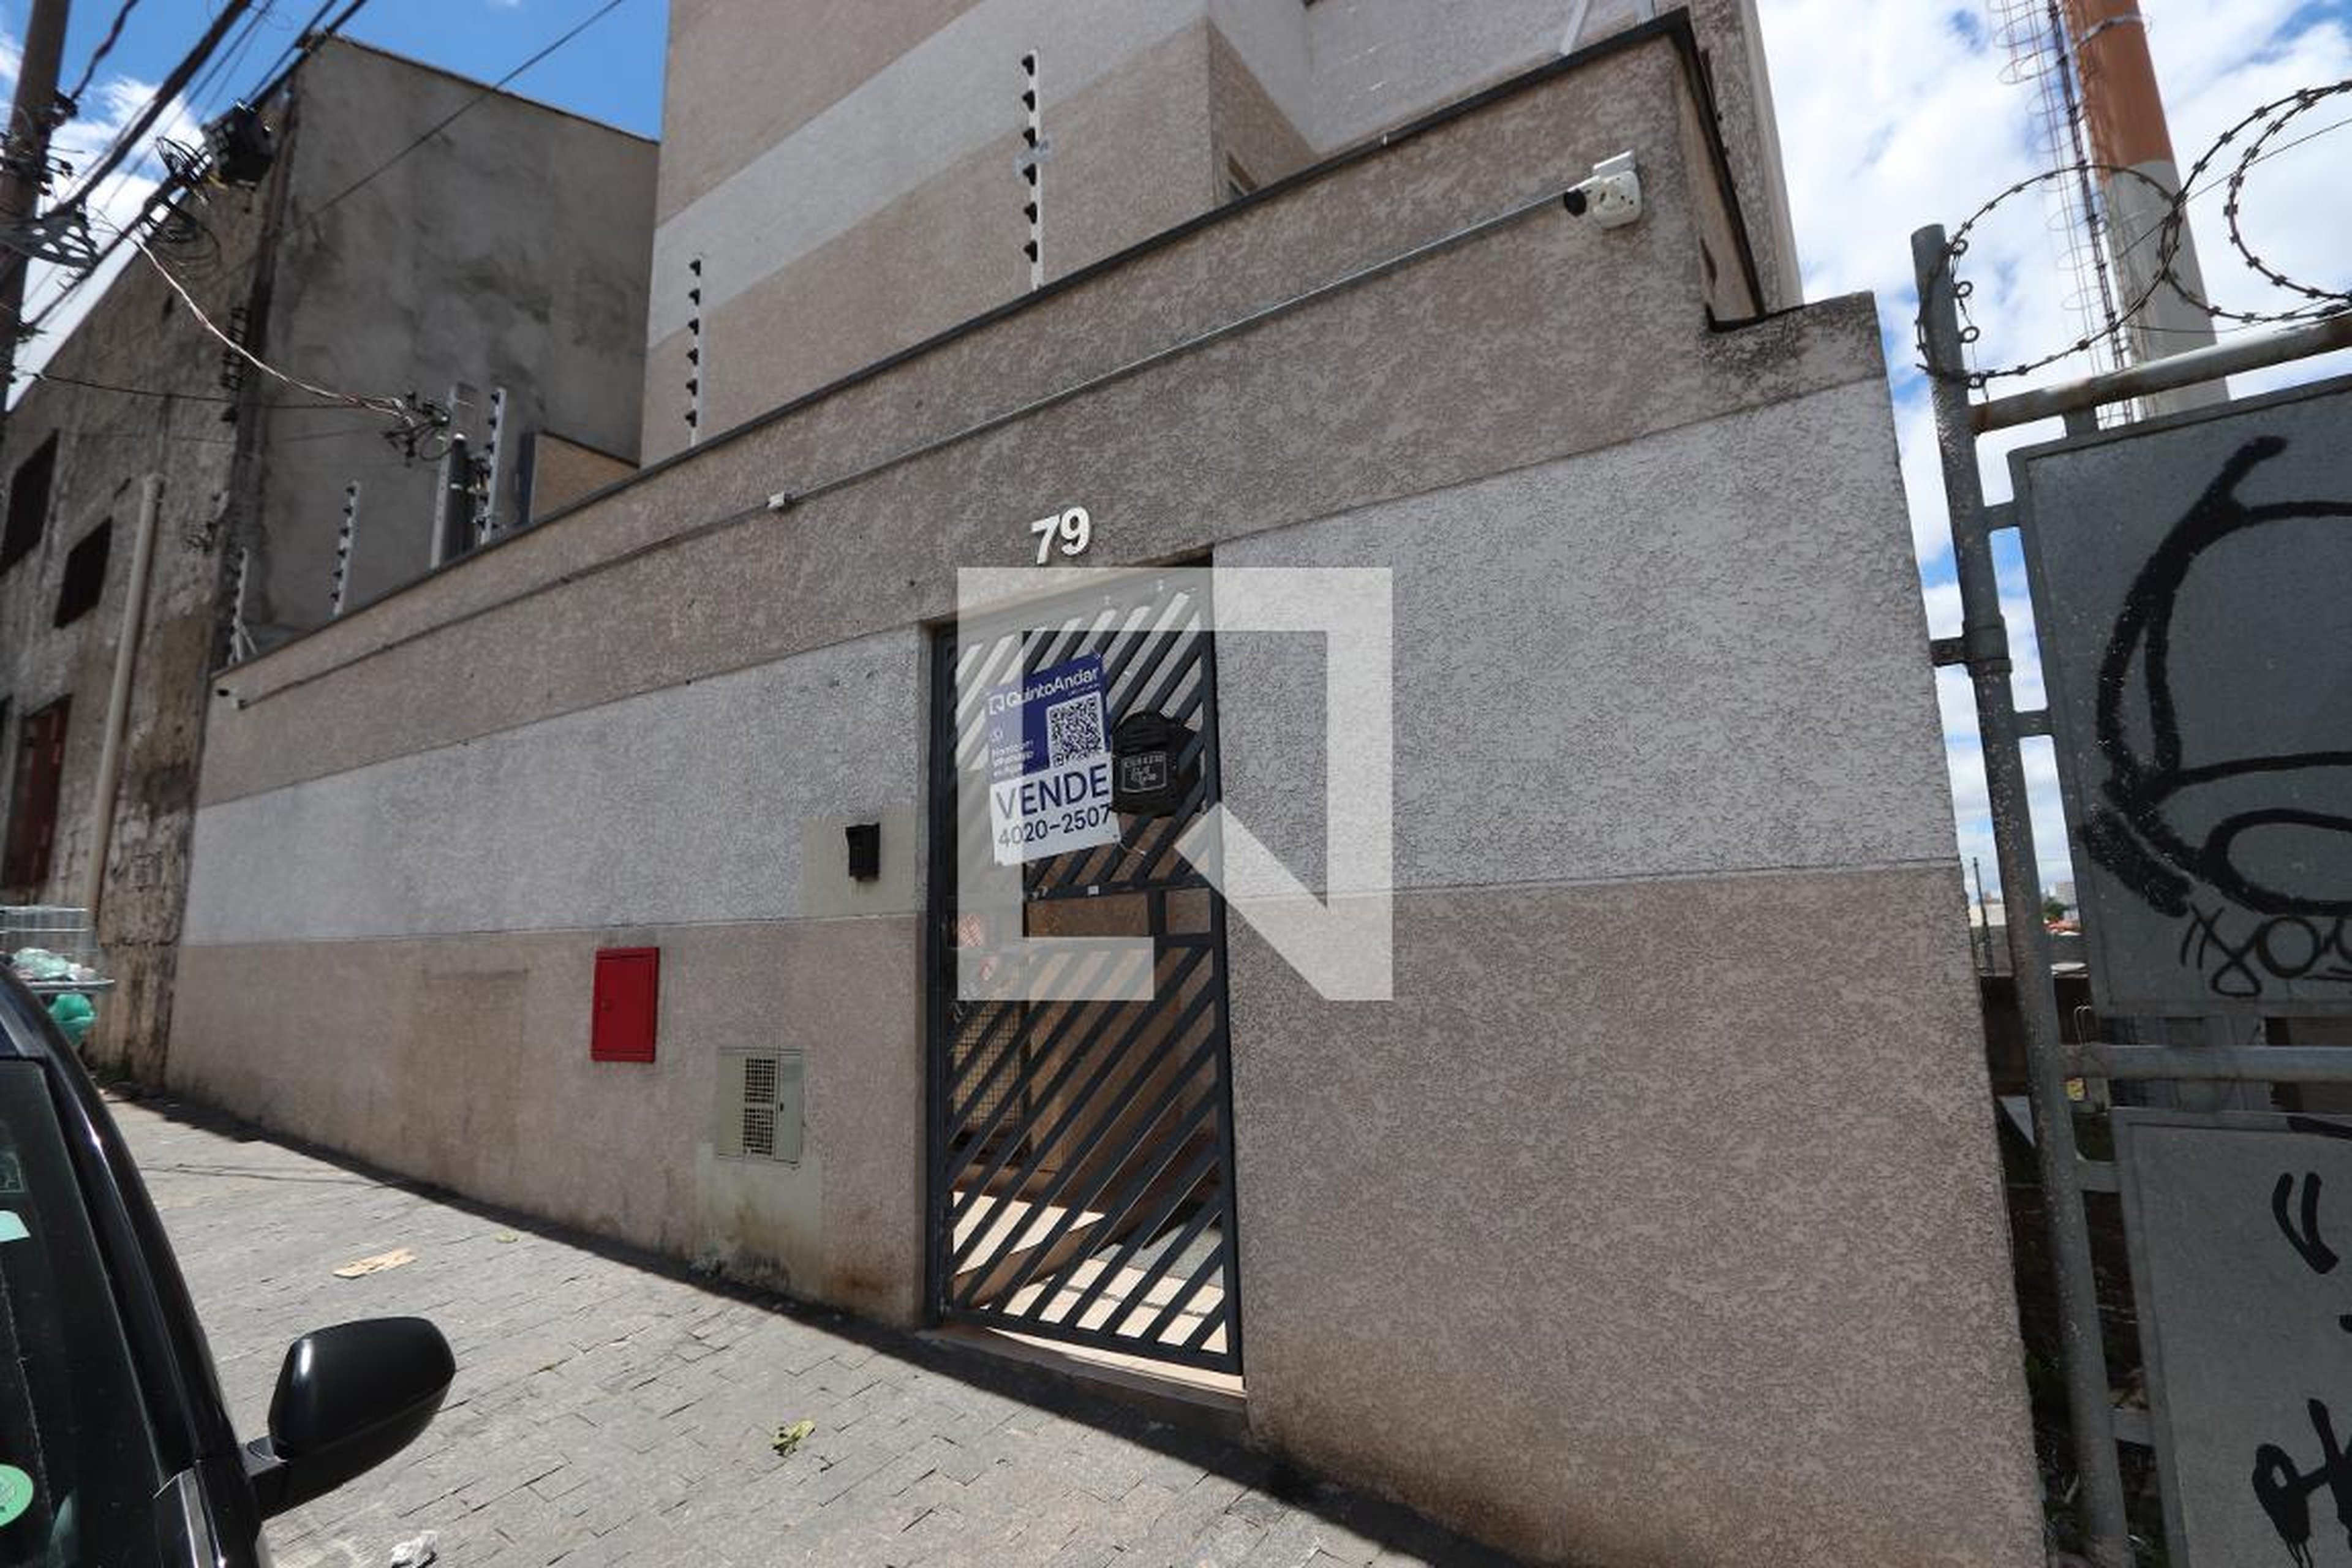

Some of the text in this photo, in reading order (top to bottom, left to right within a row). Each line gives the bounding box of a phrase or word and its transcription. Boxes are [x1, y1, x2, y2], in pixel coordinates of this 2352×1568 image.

[1031, 507, 1089, 564] 79
[1006, 668, 1099, 707] QuintoAndar
[995, 764, 1110, 820] VENDE
[998, 804, 1111, 847] 4020-2507
